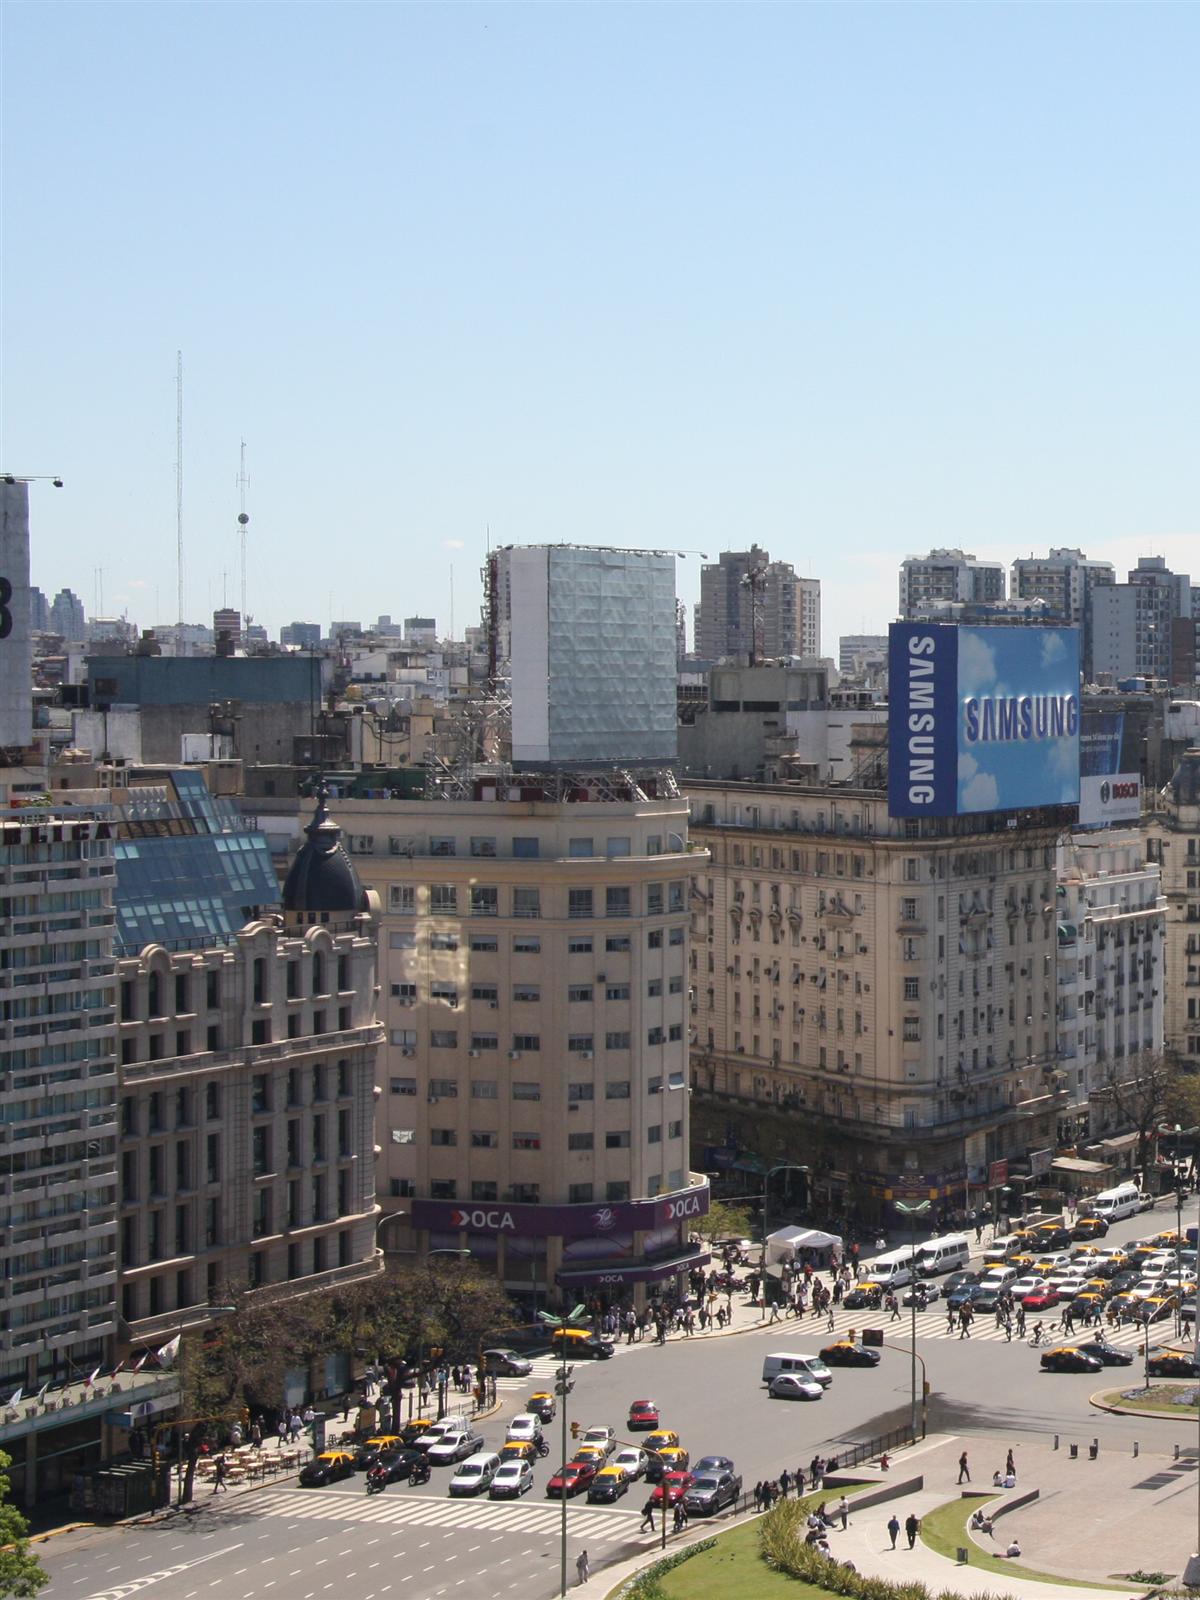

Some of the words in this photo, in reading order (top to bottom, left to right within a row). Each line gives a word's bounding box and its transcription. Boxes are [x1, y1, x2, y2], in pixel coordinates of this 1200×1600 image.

[908, 636, 936, 804] SAMSUNG
[964, 694, 1078, 742] SAMSUNG
[1112, 782, 1139, 799] BOSCH
[676, 1196, 700, 1217] OCA
[471, 1210, 515, 1229] OCA
[604, 1274, 624, 1283] OCA
